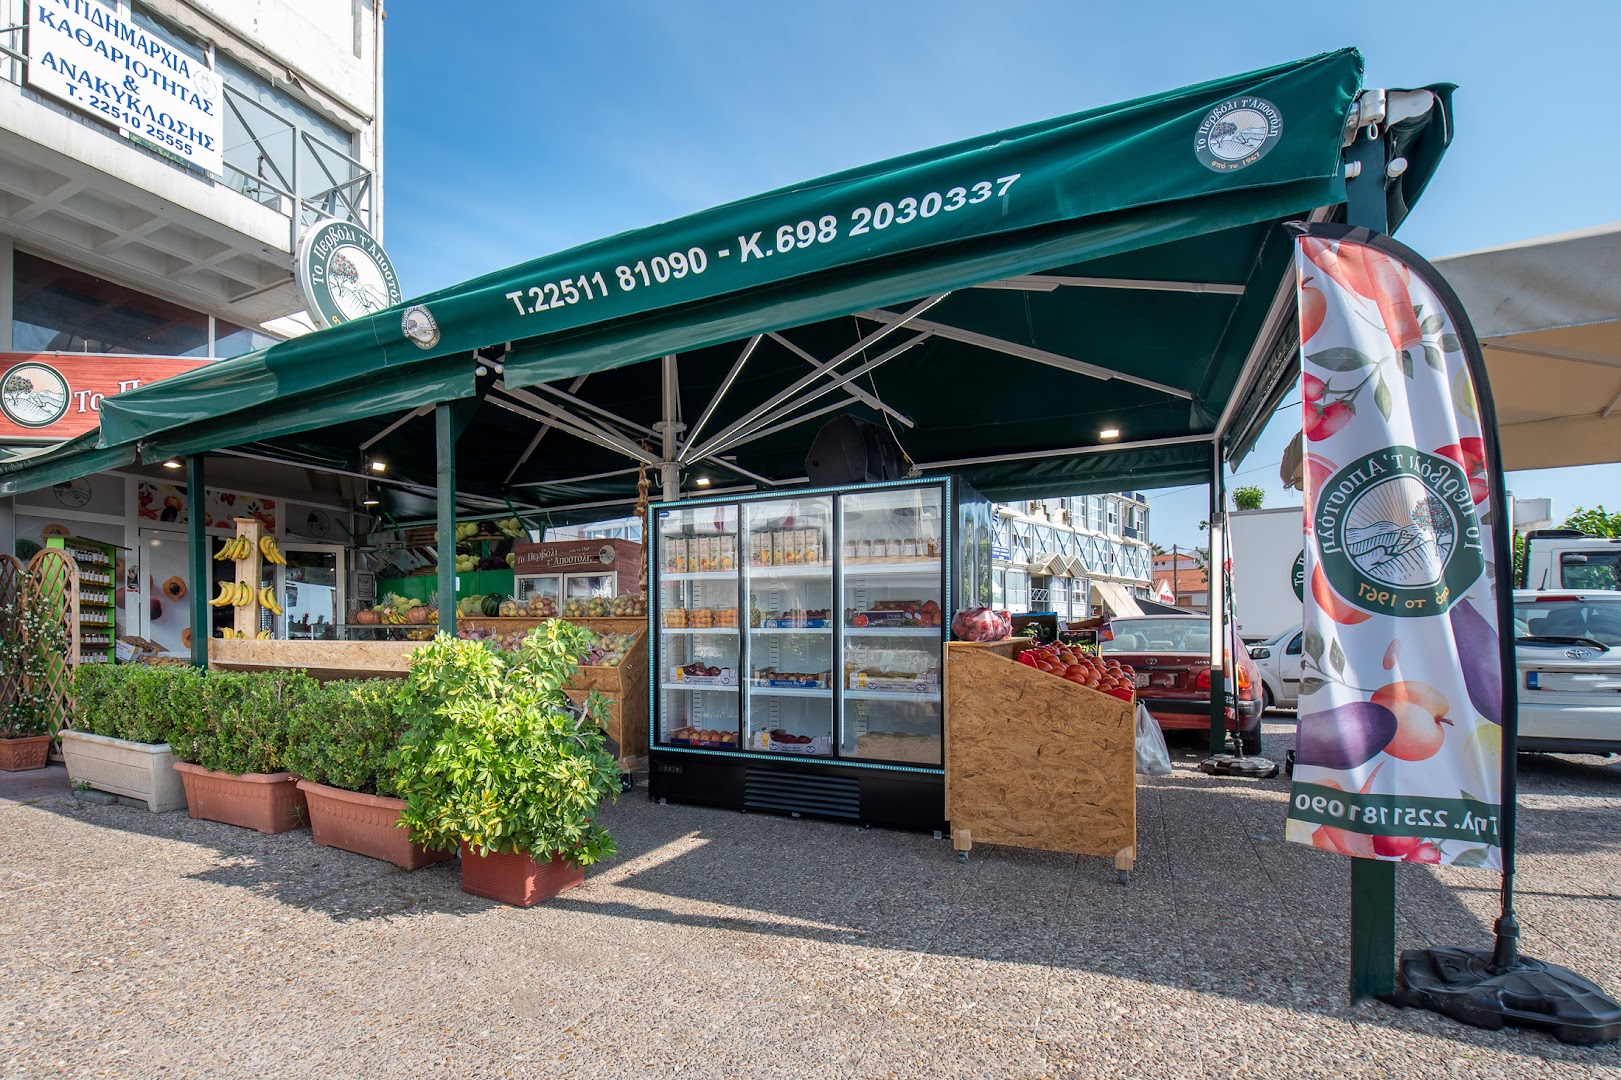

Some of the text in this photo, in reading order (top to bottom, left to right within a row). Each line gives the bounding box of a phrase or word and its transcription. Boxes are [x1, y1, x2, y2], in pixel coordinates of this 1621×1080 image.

[38, 5, 214, 117] ΚΑΘΑΡΙΟΤΗΤΑΣ
[123, 74, 140, 95] &
[40, 51, 215, 152] ΑΝΑΚΥΚΛΩΣΗΣ
[89, 95, 141, 129] 22510
[146, 124, 193, 155] 25555
[1198, 101, 1237, 134] Περβόλι
[1196, 138, 1206, 152] Το
[1211, 160, 1226, 169] από
[1242, 151, 1260, 166] 1967
[313, 225, 357, 260] Περβόλι
[506, 271, 608, 316] Τ.22511
[616, 247, 708, 292] 81090
[738, 214, 838, 263] Κ.698
[848, 173, 1021, 237] 2030337
[312, 264, 325, 285] Το
[74, 389, 105, 413] Το
[517, 547, 558, 564] Το Περβόλι
